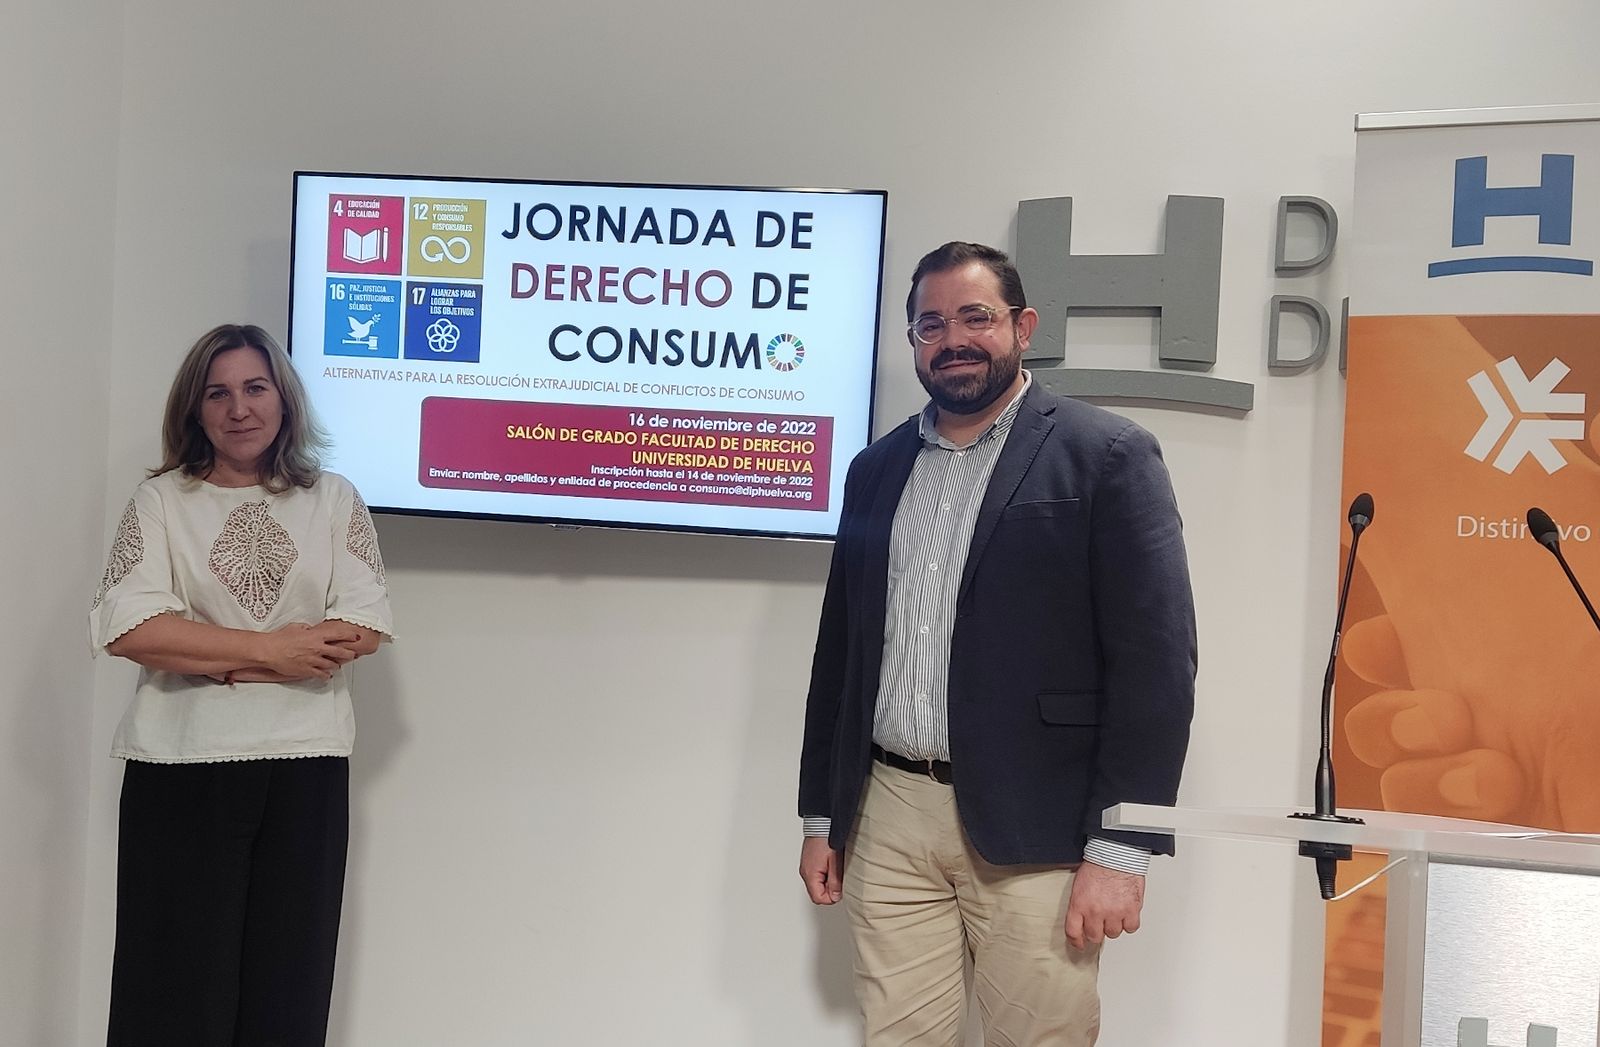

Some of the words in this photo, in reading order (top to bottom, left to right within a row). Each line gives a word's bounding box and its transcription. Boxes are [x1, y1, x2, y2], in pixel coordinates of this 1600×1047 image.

[333, 200, 343, 216] 4
[348, 199, 380, 209] EDUCACIÓN
[413, 203, 429, 220] 12
[347, 210, 355, 218] DE
[356, 210, 380, 219] CALIDAD
[432, 213, 437, 221] Y
[437, 213, 464, 222] CONSUMO
[501, 202, 736, 247] JORNADA
[755, 210, 814, 250] DE
[329, 283, 346, 300] 16
[362, 284, 386, 294] JUSTICIA
[431, 288, 460, 298] ALIANZAS
[460, 289, 476, 299] PARA
[510, 262, 733, 308] DERECHO
[752, 271, 810, 311] DE
[411, 287, 426, 305] 17
[430, 297, 454, 306] LOGRAR
[430, 306, 442, 315] LOS
[442, 306, 475, 317] OBJETIVOS
[322, 366, 403, 382] ALTERNATIVAS
[405, 370, 437, 384] PARA
[439, 372, 454, 384] LA
[456, 373, 530, 388] RESOLUCIÓN
[533, 377, 620, 393] EXTRAJUDICIAL
[623, 382, 638, 394] DE
[640, 383, 717, 398] CONFLICTOS
[719, 387, 735, 398] DE
[737, 387, 805, 402] CONSUMO
[628, 412, 645, 427] 16
[649, 414, 669, 428] de
[672, 416, 753, 432] noviembre
[756, 419, 777, 434] de
[780, 420, 817, 436] 2022
[507, 423, 555, 441] SALÓN
[559, 428, 579, 442] DE
[582, 429, 637, 445] GRADO
[641, 432, 716, 449] FACULTAD
[720, 437, 740, 450] DE
[743, 437, 815, 454] DERECHO
[632, 451, 729, 468] UNIVERSIDAD
[733, 456, 752, 470] DE
[756, 458, 814, 474] HUELVA
[429, 467, 460, 479] Enviar:
[461, 470, 502, 482] nombre,
[504, 472, 548, 484] apellidos
[550, 476, 556, 486] y
[598, 478, 612, 487] de
[613, 478, 678, 491] procedencia
[679, 484, 687, 492] a
[688, 484, 812, 501] consumo@diphuelva.org
[591, 464, 644, 477] Inscripción
[645, 466, 673, 479] hasta
[675, 470, 685, 479] el
[687, 470, 699, 480] 14
[700, 471, 714, 481] de
[717, 472, 771, 484] noviembre
[772, 475, 787, 485] de
[788, 476, 814, 487] 2022
[1457, 515, 1591, 542] Distinvo
